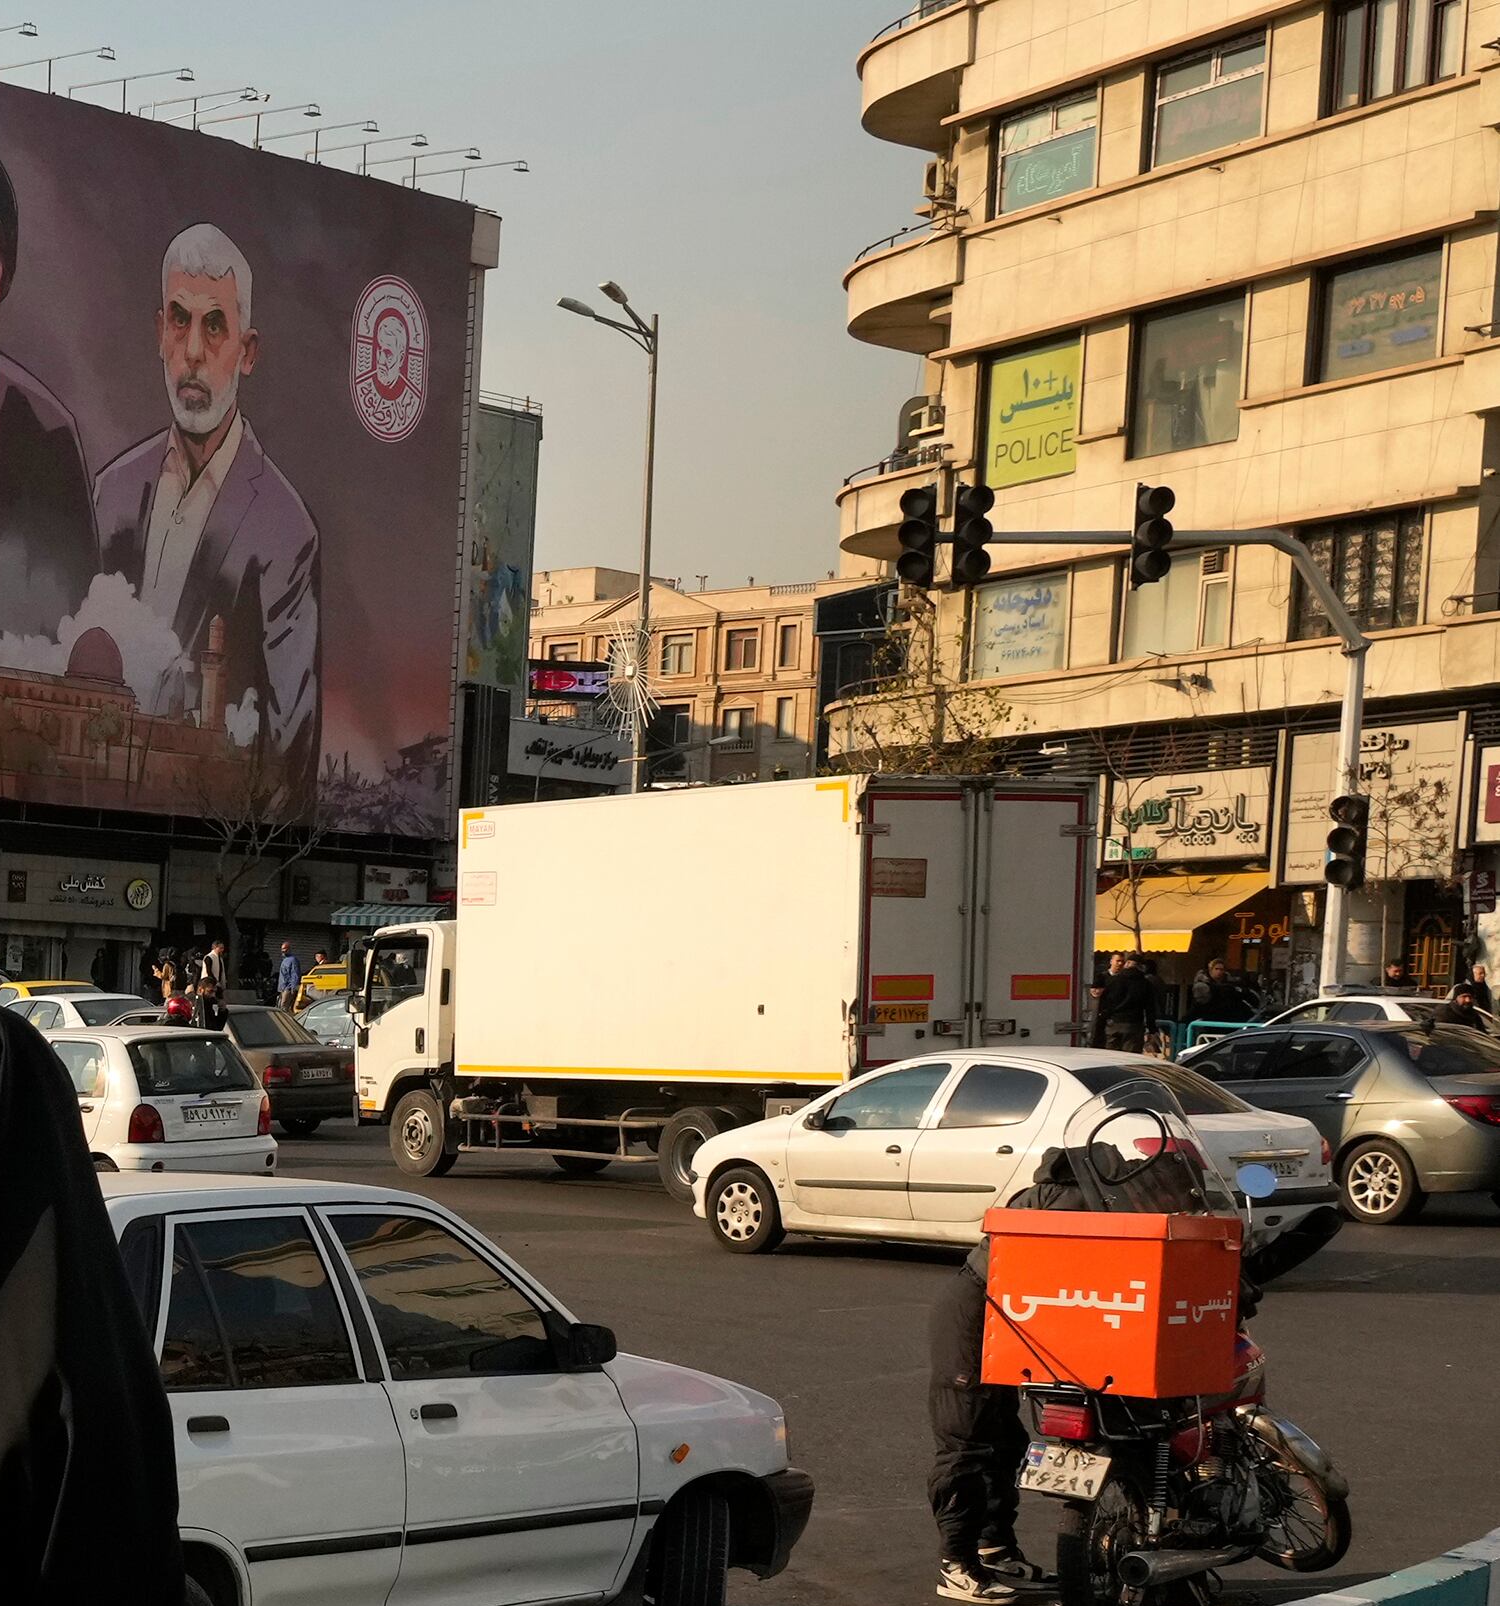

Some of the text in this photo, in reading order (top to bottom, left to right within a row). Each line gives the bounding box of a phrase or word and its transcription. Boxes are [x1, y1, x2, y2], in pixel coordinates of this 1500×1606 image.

[1000, 375, 1074, 424] پلیس
[995, 427, 1074, 468] POLICE
[60, 873, 106, 893] کفش ملی
[1002, 1280, 1146, 1329] تپسی
[1192, 1288, 1233, 1323] تپسی
